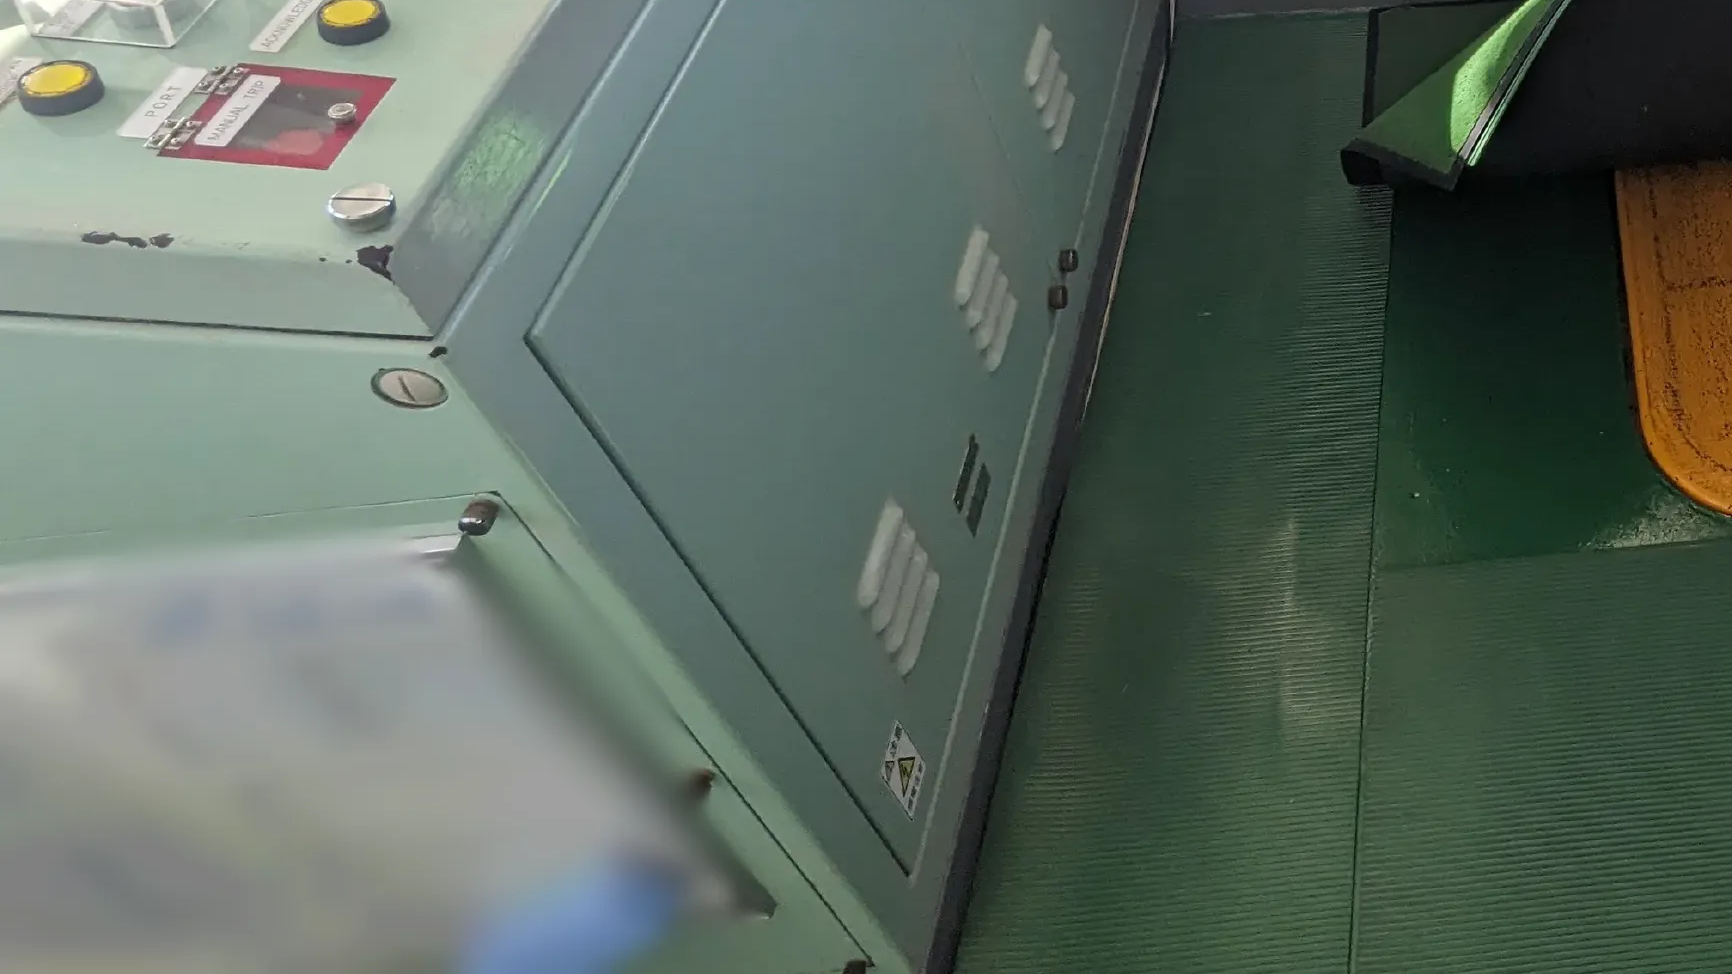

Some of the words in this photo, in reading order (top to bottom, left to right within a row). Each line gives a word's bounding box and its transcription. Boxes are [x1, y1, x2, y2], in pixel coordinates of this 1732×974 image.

[144, 85, 183, 119] PORT
[207, 105, 249, 142] MANUAL
[243, 80, 265, 105] TRIP
